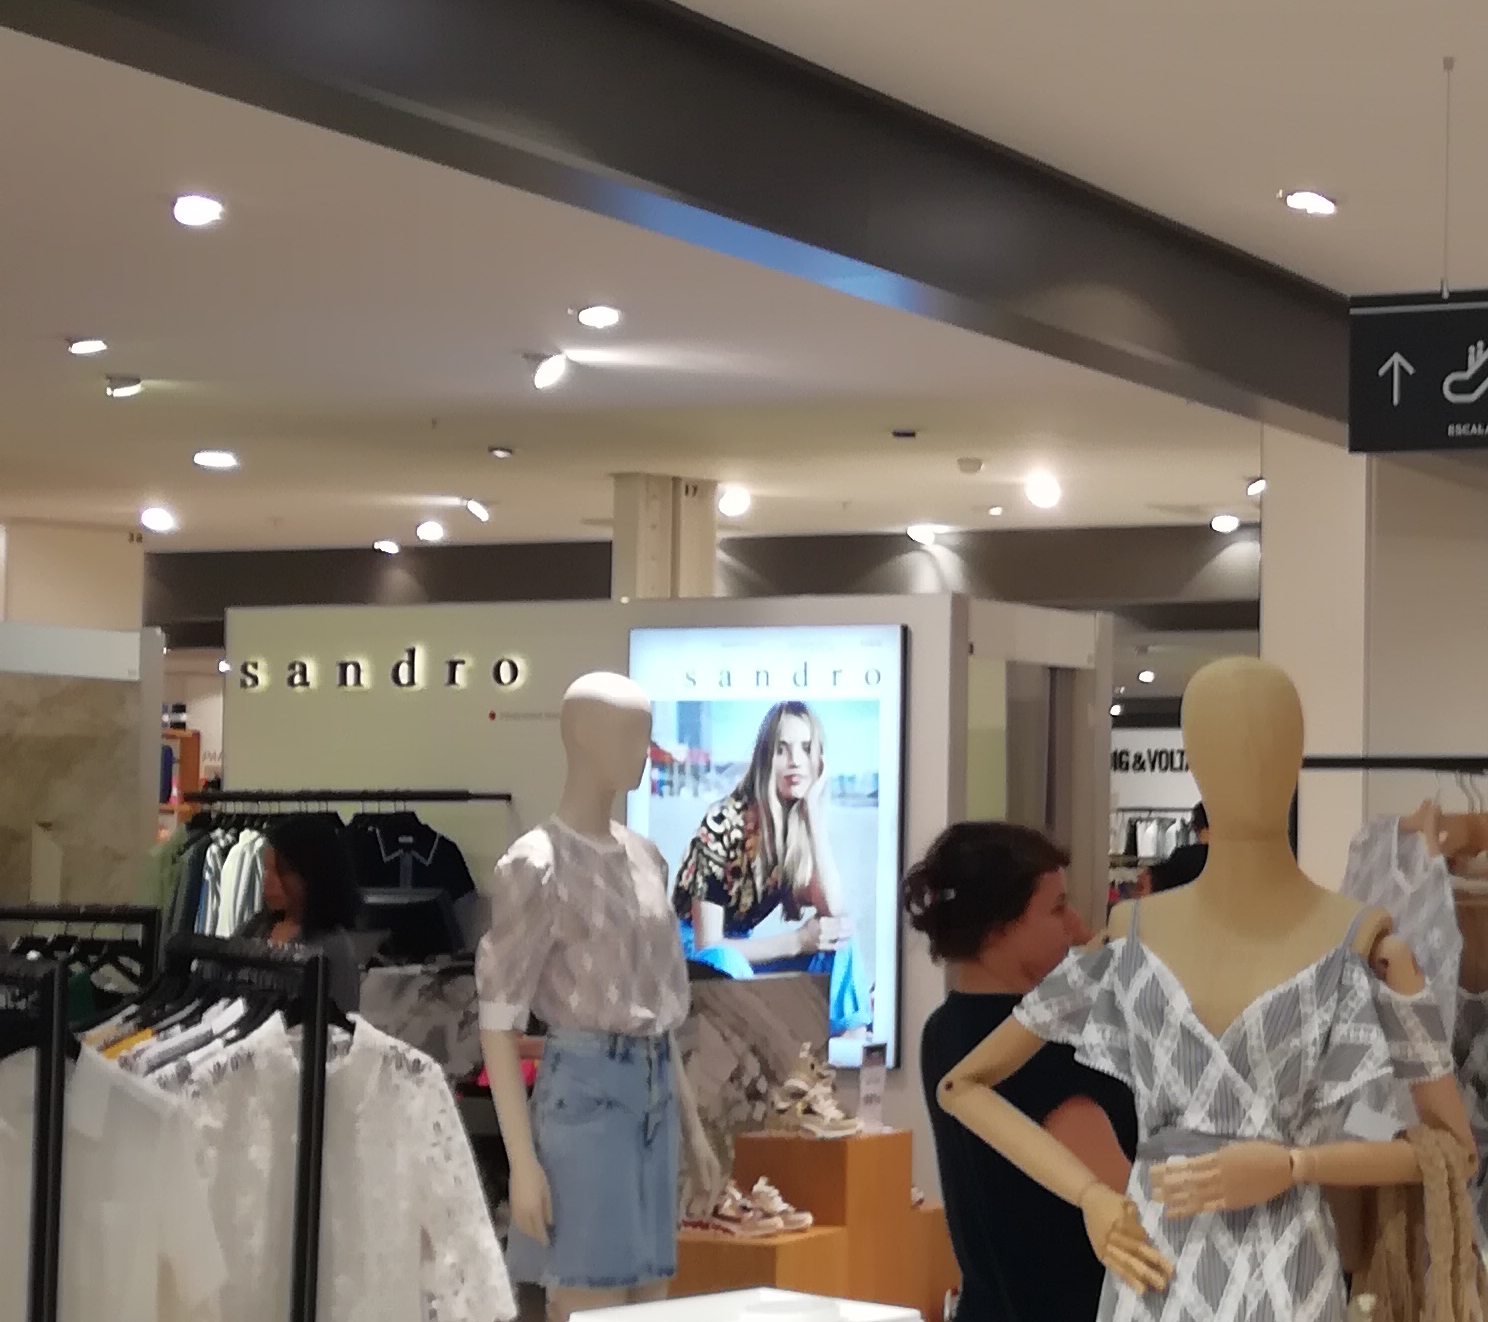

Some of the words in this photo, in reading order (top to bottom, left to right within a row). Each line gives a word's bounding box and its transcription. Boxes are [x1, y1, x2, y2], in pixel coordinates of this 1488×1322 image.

[239, 645, 520, 689] sandro
[685, 661, 882, 687] sandro
[1132, 752, 1145, 773] &
[1147, 748, 1189, 773] VOLT
